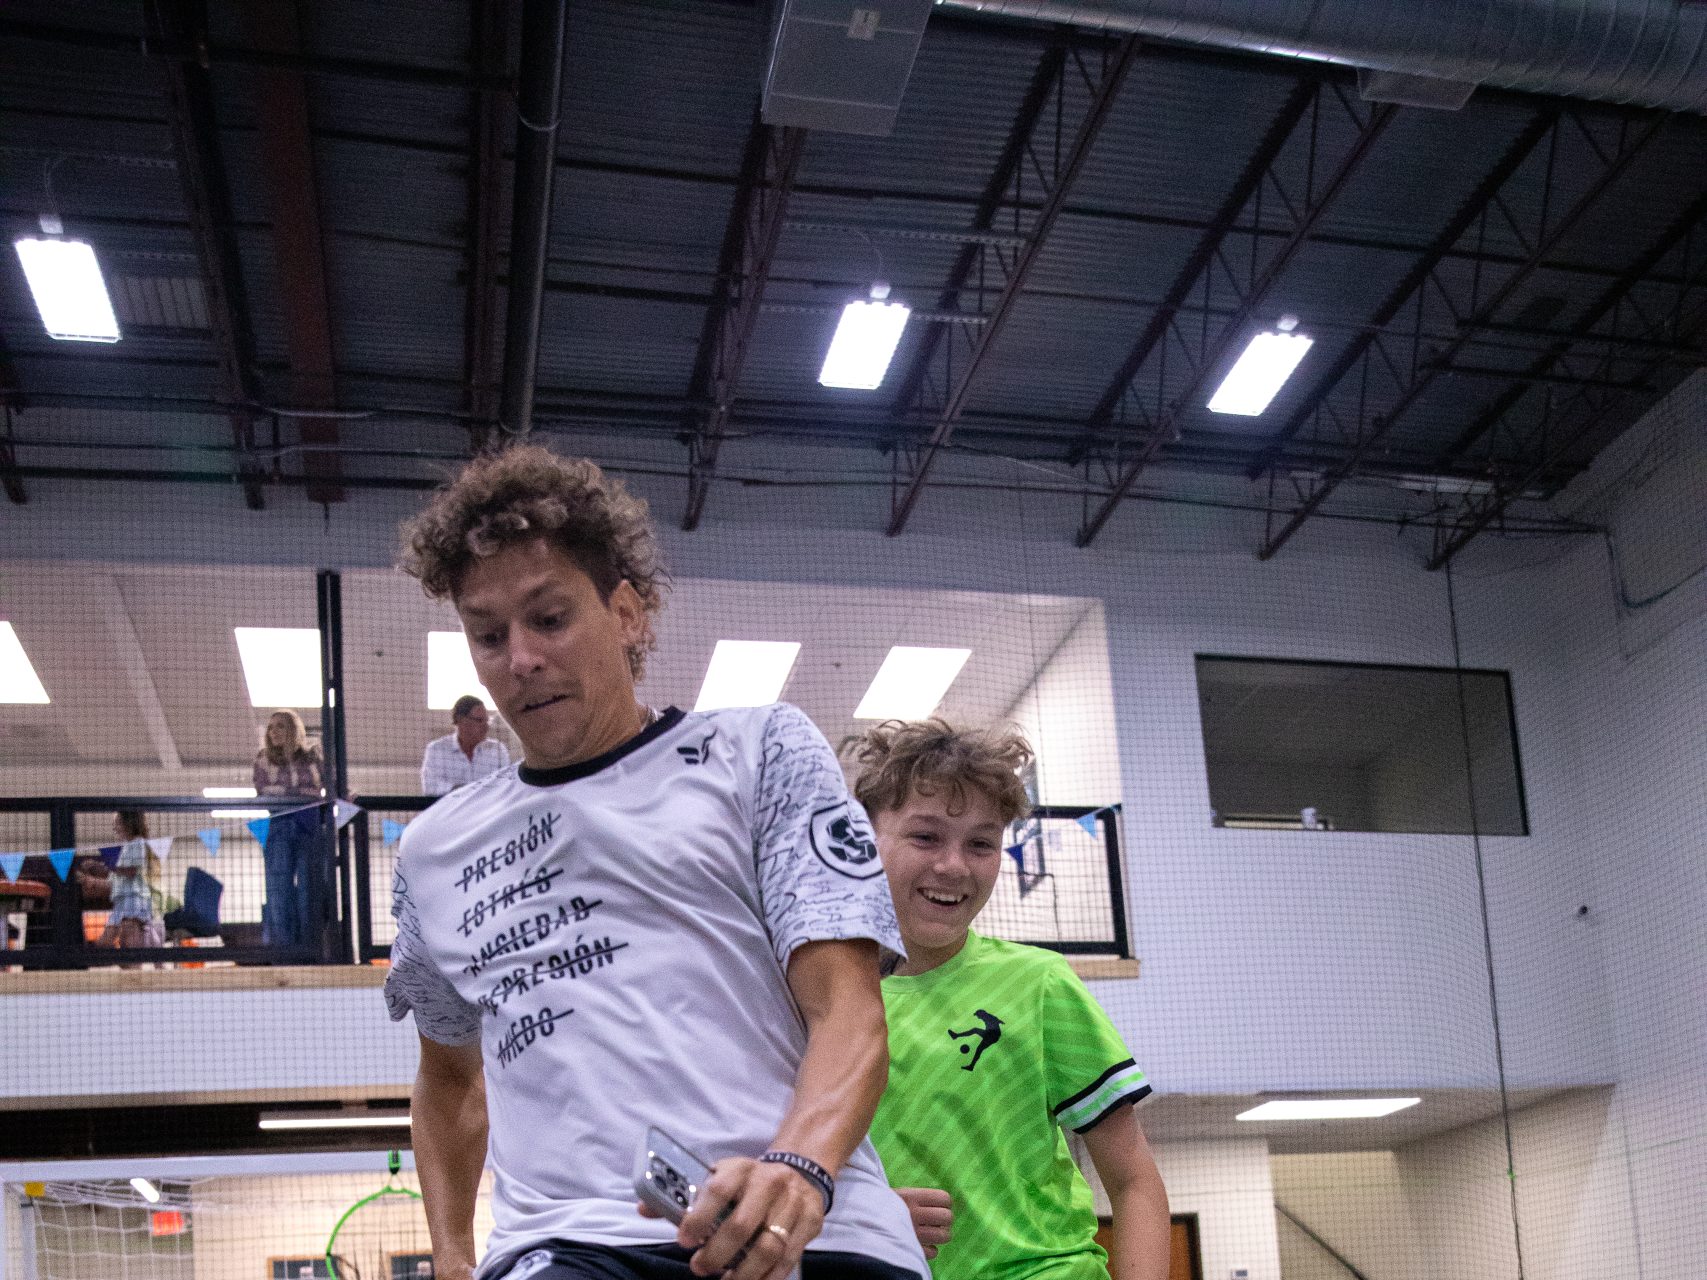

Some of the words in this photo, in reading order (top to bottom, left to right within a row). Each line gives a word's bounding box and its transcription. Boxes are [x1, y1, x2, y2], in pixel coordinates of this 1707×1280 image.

[461, 812, 555, 892] PRESIÓN
[460, 867, 555, 937] ESTRÉS
[498, 1006, 558, 1069] MIEDO
